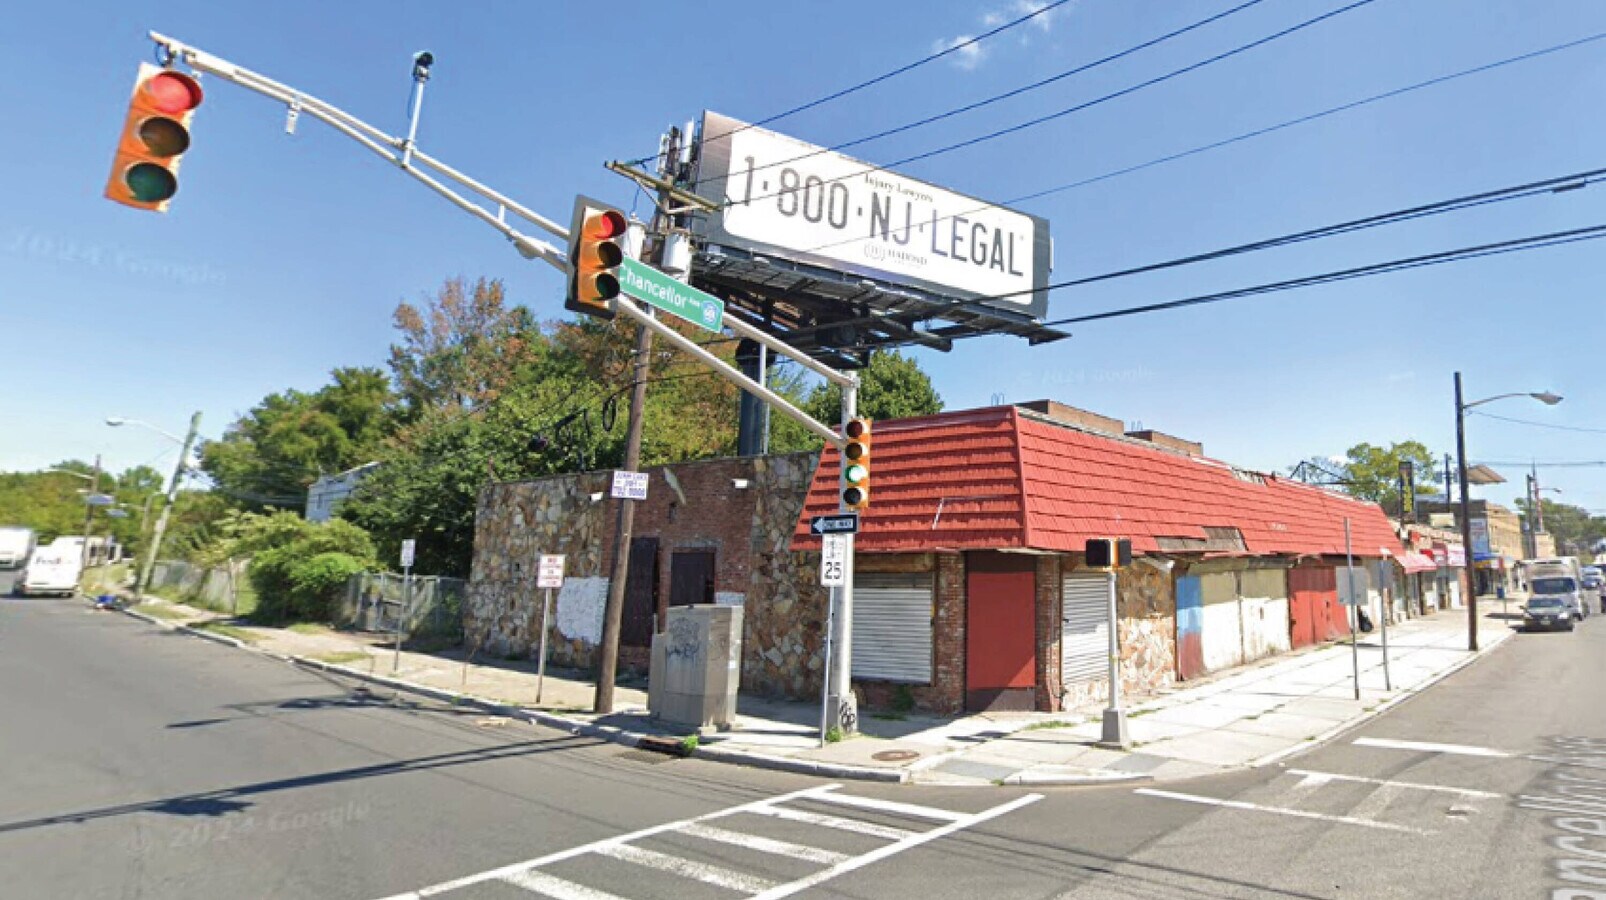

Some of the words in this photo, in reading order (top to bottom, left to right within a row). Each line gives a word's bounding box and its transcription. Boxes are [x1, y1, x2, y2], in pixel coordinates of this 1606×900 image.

[865, 172, 895, 193] Injury
[896, 182, 934, 203] Lawyers
[824, 562, 842, 579] 25
